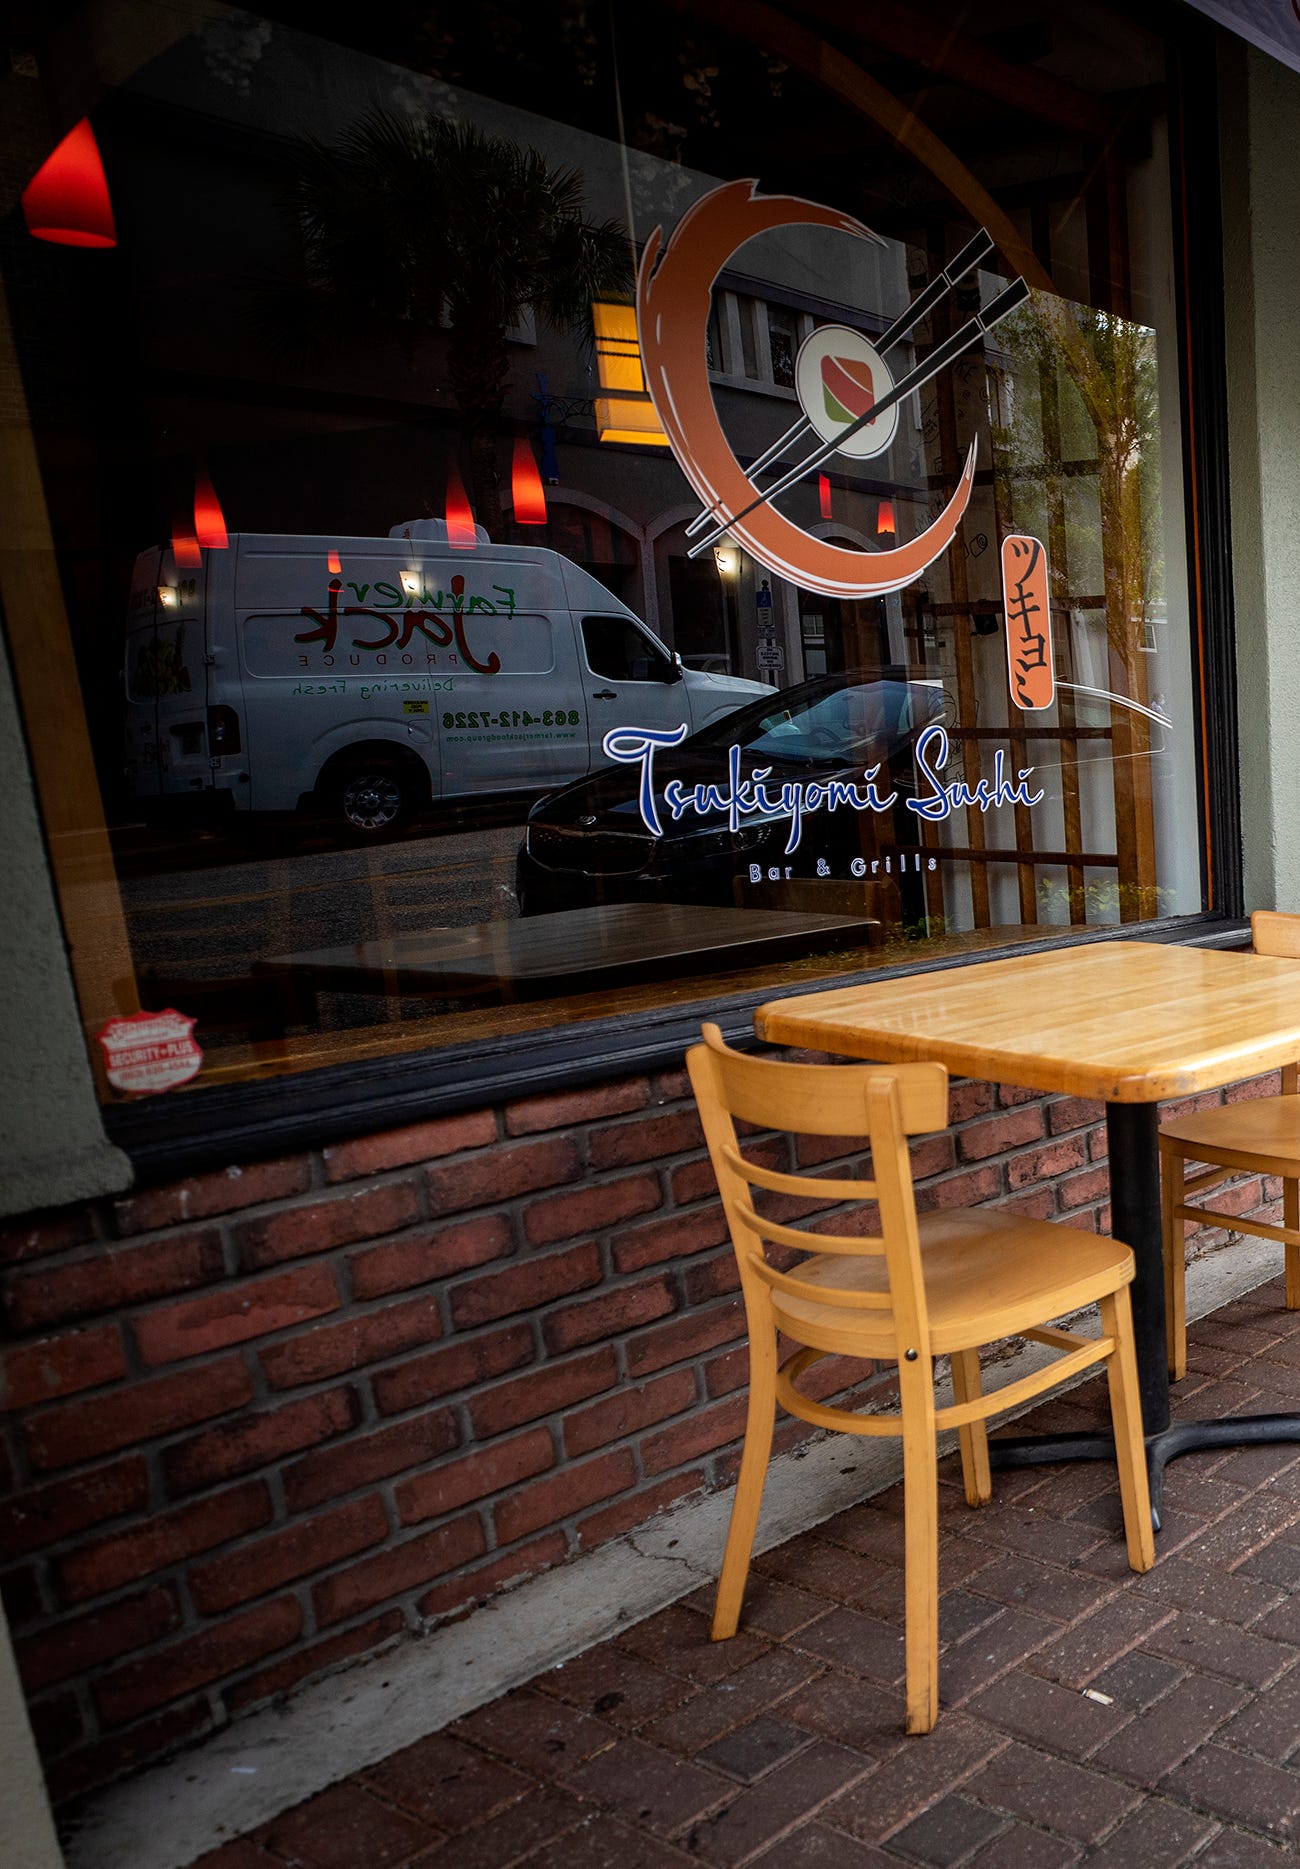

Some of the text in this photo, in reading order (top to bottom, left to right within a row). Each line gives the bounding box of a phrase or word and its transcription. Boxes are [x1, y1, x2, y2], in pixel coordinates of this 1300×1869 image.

[602, 722, 1045, 855] Tsukiyomi Sushi
[748, 853, 938, 884] Bar & Grills
